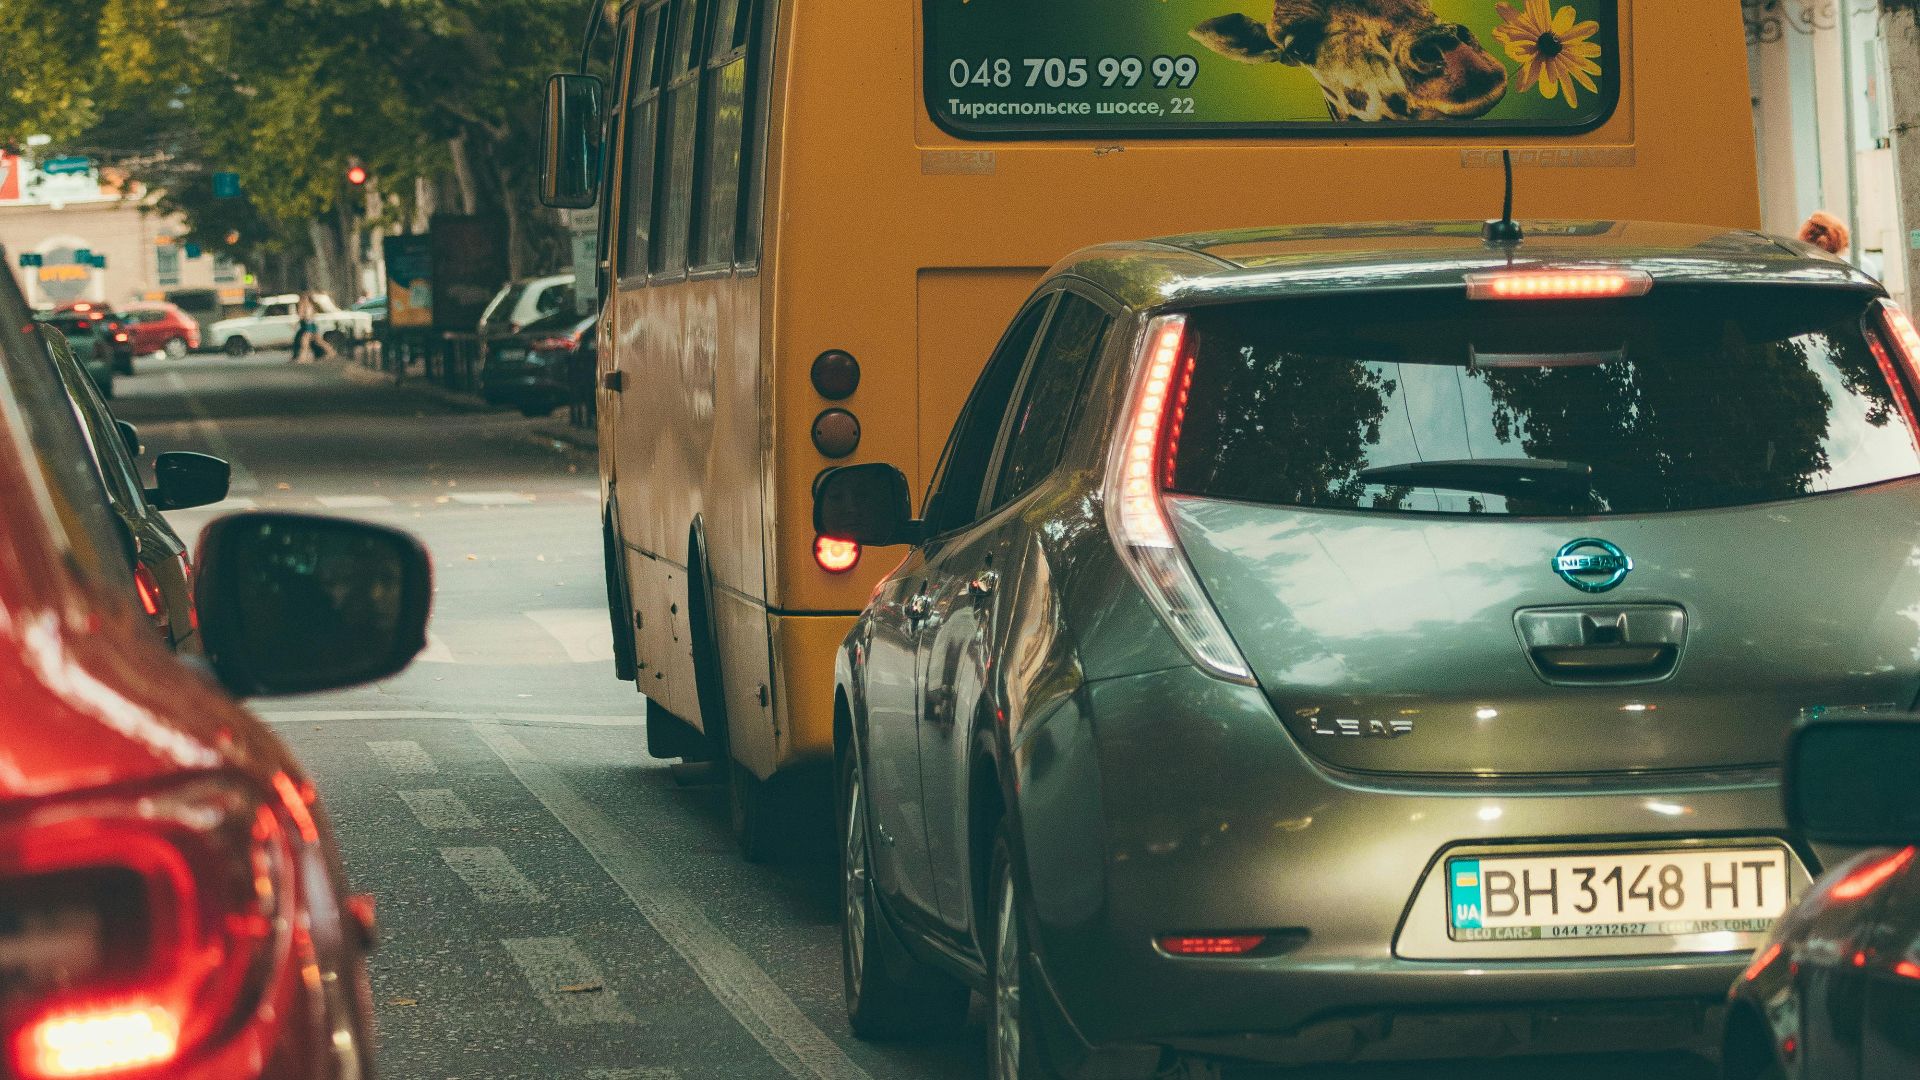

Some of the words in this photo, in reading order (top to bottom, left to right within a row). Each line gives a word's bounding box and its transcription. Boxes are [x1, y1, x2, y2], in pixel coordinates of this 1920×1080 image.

[949, 58, 1012, 88] 048
[1023, 57, 1088, 88] 705
[1099, 57, 1143, 87] 99
[1152, 57, 1197, 87] 99
[949, 98, 1091, 118] Тираспольске
[1096, 102, 1165, 116] шоссе,
[1170, 97, 1195, 114] 22
[1560, 557, 1625, 569] NISSAN
[1310, 718, 1413, 737] LEAF
[1485, 868, 1559, 917] BH
[1572, 864, 1685, 914] 3148
[1704, 860, 1776, 909] HT
[1457, 904, 1480, 920] UA
[1466, 928, 1491, 939] ECO
[1496, 926, 1533, 939] CARS
[1552, 925, 1578, 937] 044
[1585, 923, 1646, 936] 2212627
